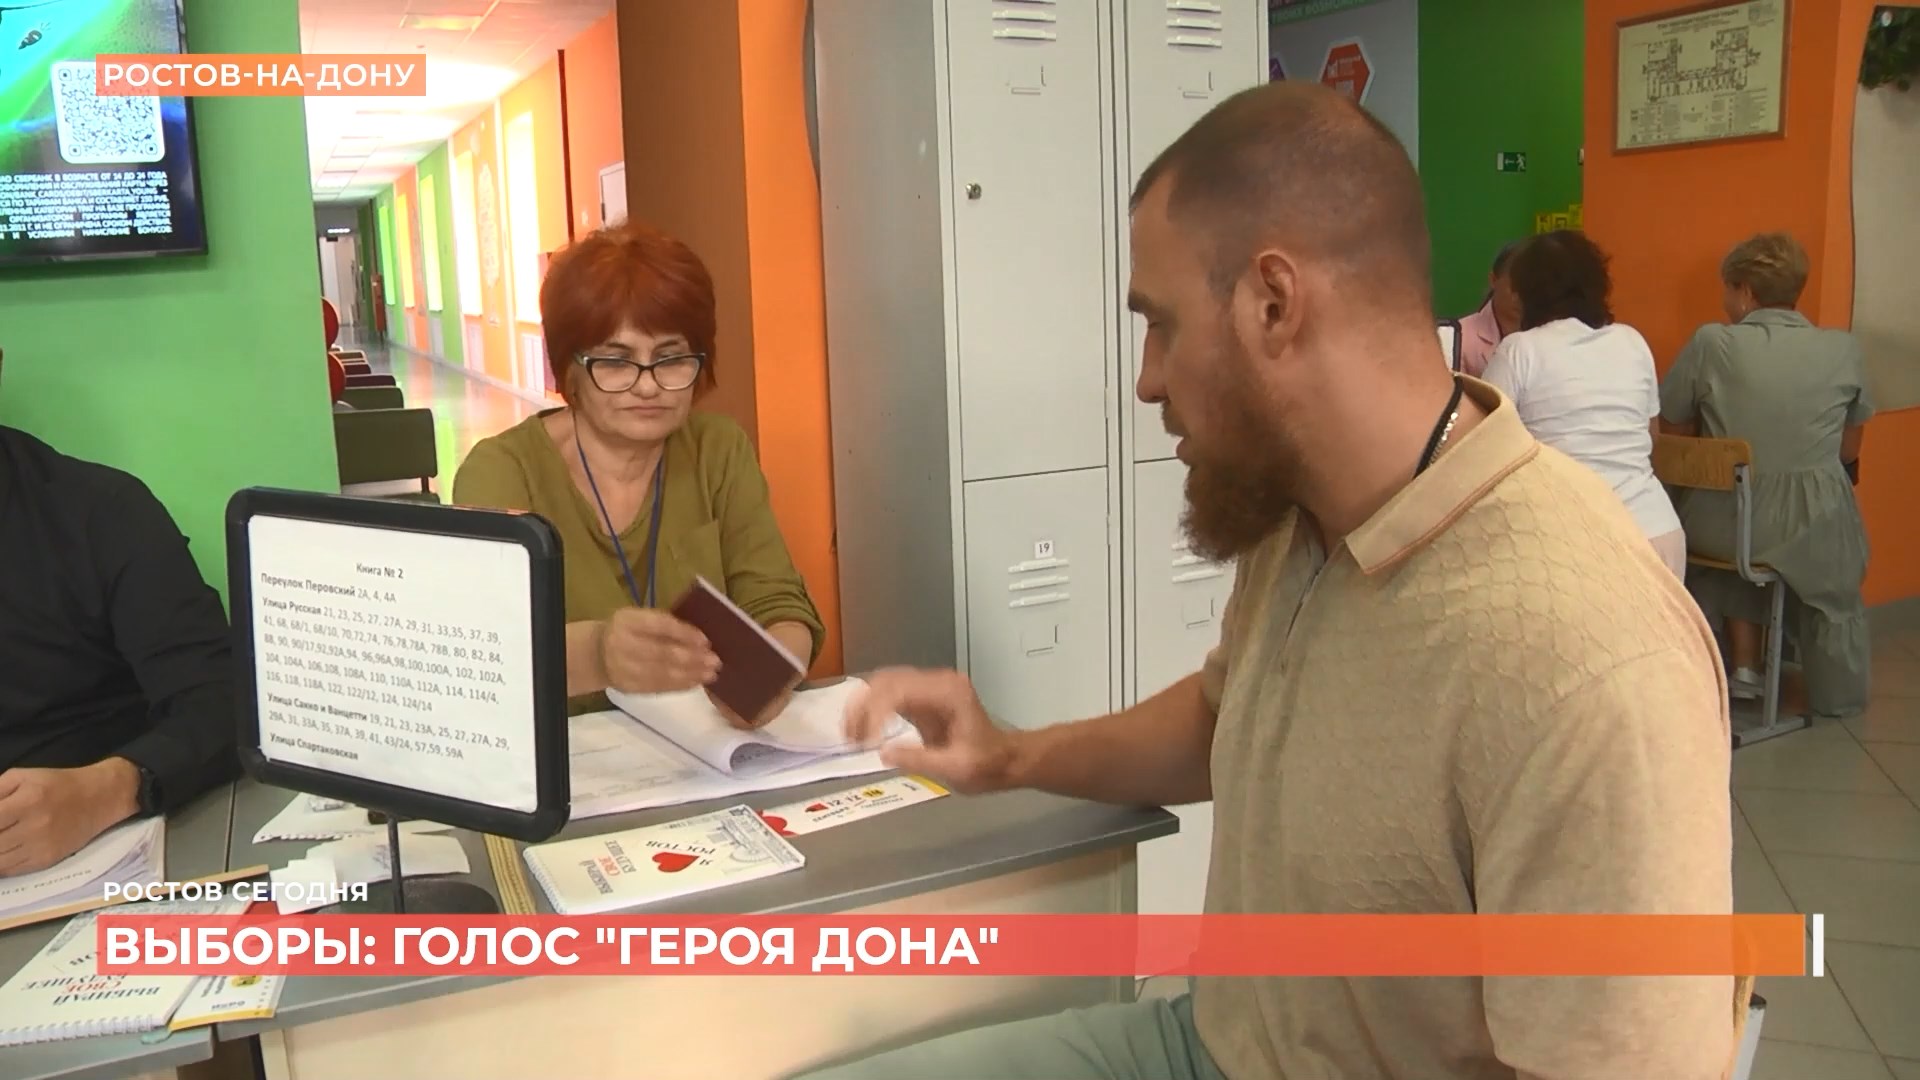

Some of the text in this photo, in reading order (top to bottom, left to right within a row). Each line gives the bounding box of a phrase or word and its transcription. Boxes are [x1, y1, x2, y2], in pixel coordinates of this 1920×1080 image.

[1038, 542, 1050, 554] 19
[356, 563, 404, 580] Книга № 2
[261, 572, 303, 589] Переулок
[305, 579, 356, 597] Перовский
[263, 597, 287, 611] Улица
[289, 601, 322, 615] Русская
[323, 606, 336, 619] 21,
[338, 609, 351, 622] 23,
[352, 611, 366, 625] 25,
[368, 613, 382, 626] 27,
[406, 619, 419, 633] 29,
[422, 622, 435, 636] 31,
[470, 629, 485, 643] 37,
[487, 631, 502, 646] 39,
[453, 647, 469, 660] 80,
[472, 649, 487, 663] 82,
[489, 652, 504, 665] 84,
[456, 667, 476, 681] 102,
[446, 685, 467, 699] 114,
[267, 692, 293, 707] Улица
[294, 698, 319, 712] Сакко
[328, 705, 368, 721] Ванцетти
[455, 729, 470, 743] 27,
[495, 736, 510, 751] 29,
[270, 732, 359, 761] Улица Спартаковская
[646, 840, 716, 856] РОСТОВ
[52, 986, 161, 1006] ВЫБИРАЙ
